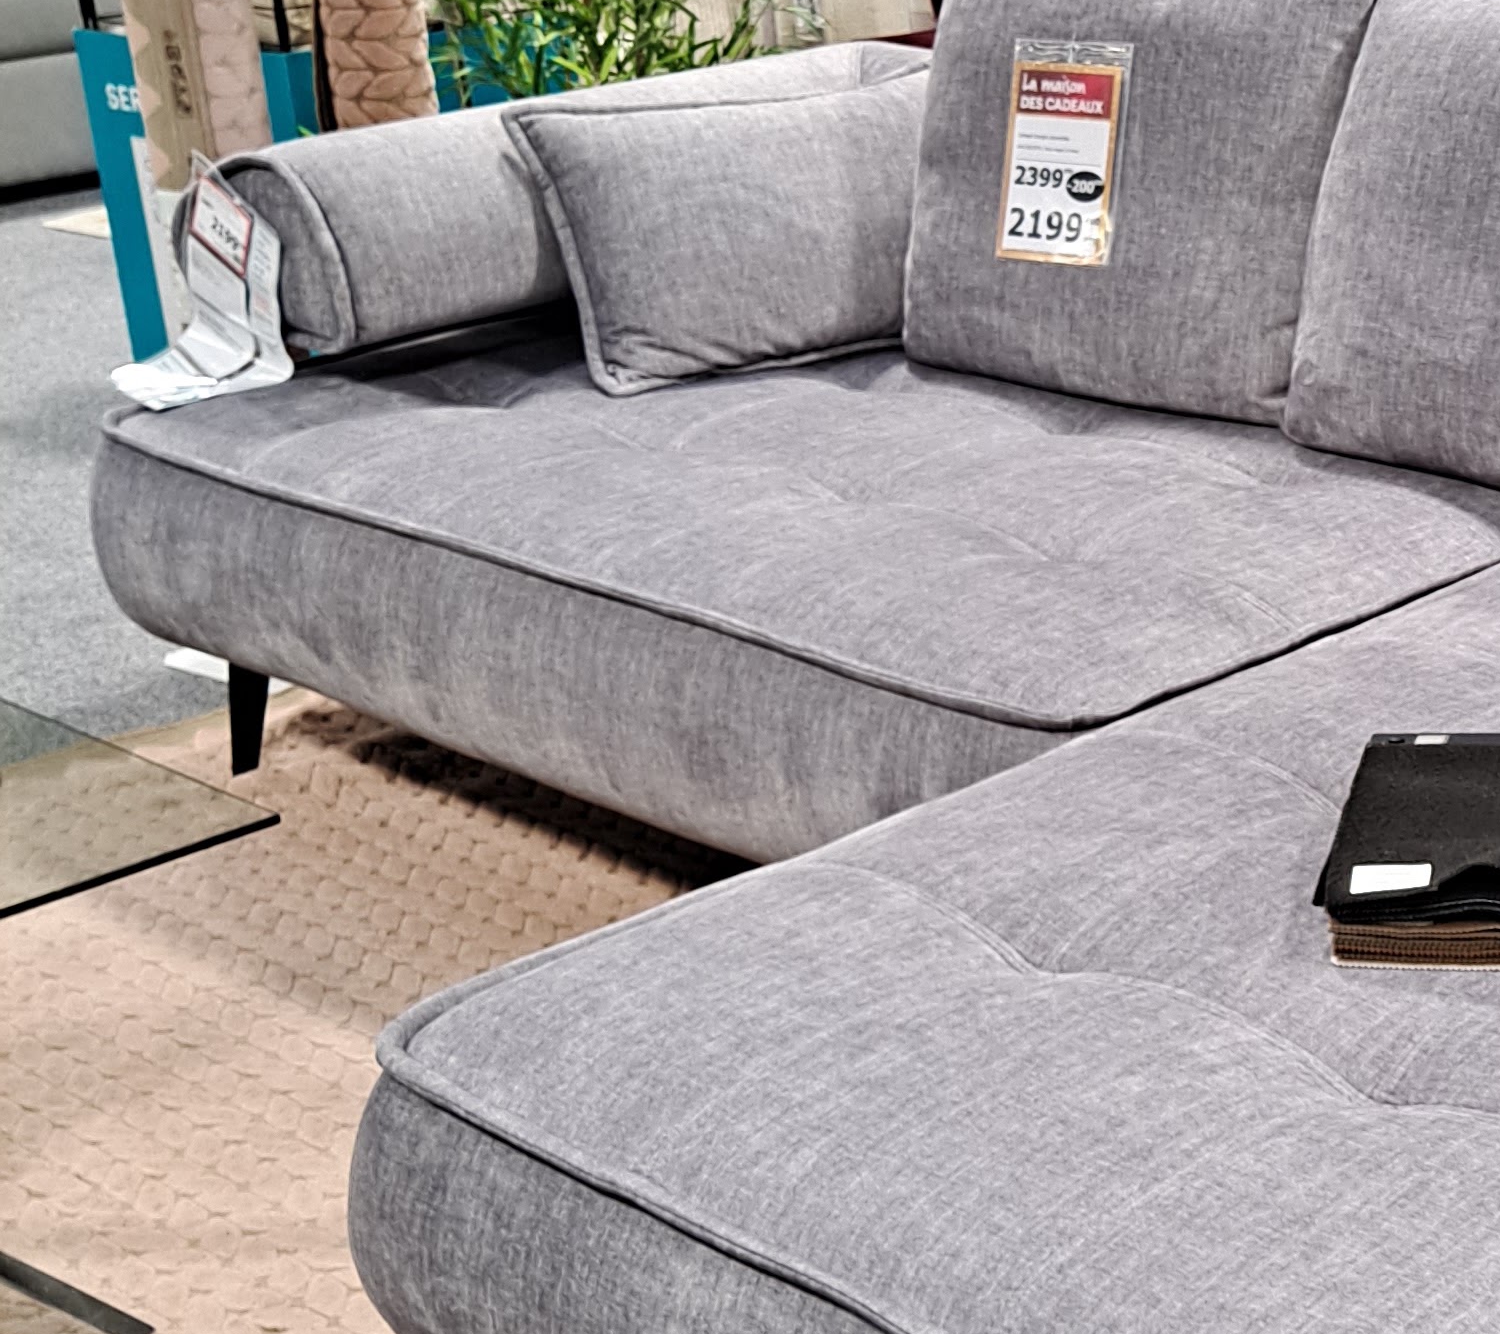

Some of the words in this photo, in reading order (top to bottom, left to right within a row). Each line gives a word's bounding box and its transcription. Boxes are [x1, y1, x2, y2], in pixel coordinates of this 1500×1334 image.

[1040, 75, 1087, 96] maison
[1019, 95, 1044, 111] DES
[1044, 97, 1105, 116] CADEAUX
[1014, 165, 1064, 189] 2399
[1007, 207, 1083, 243] 2199
